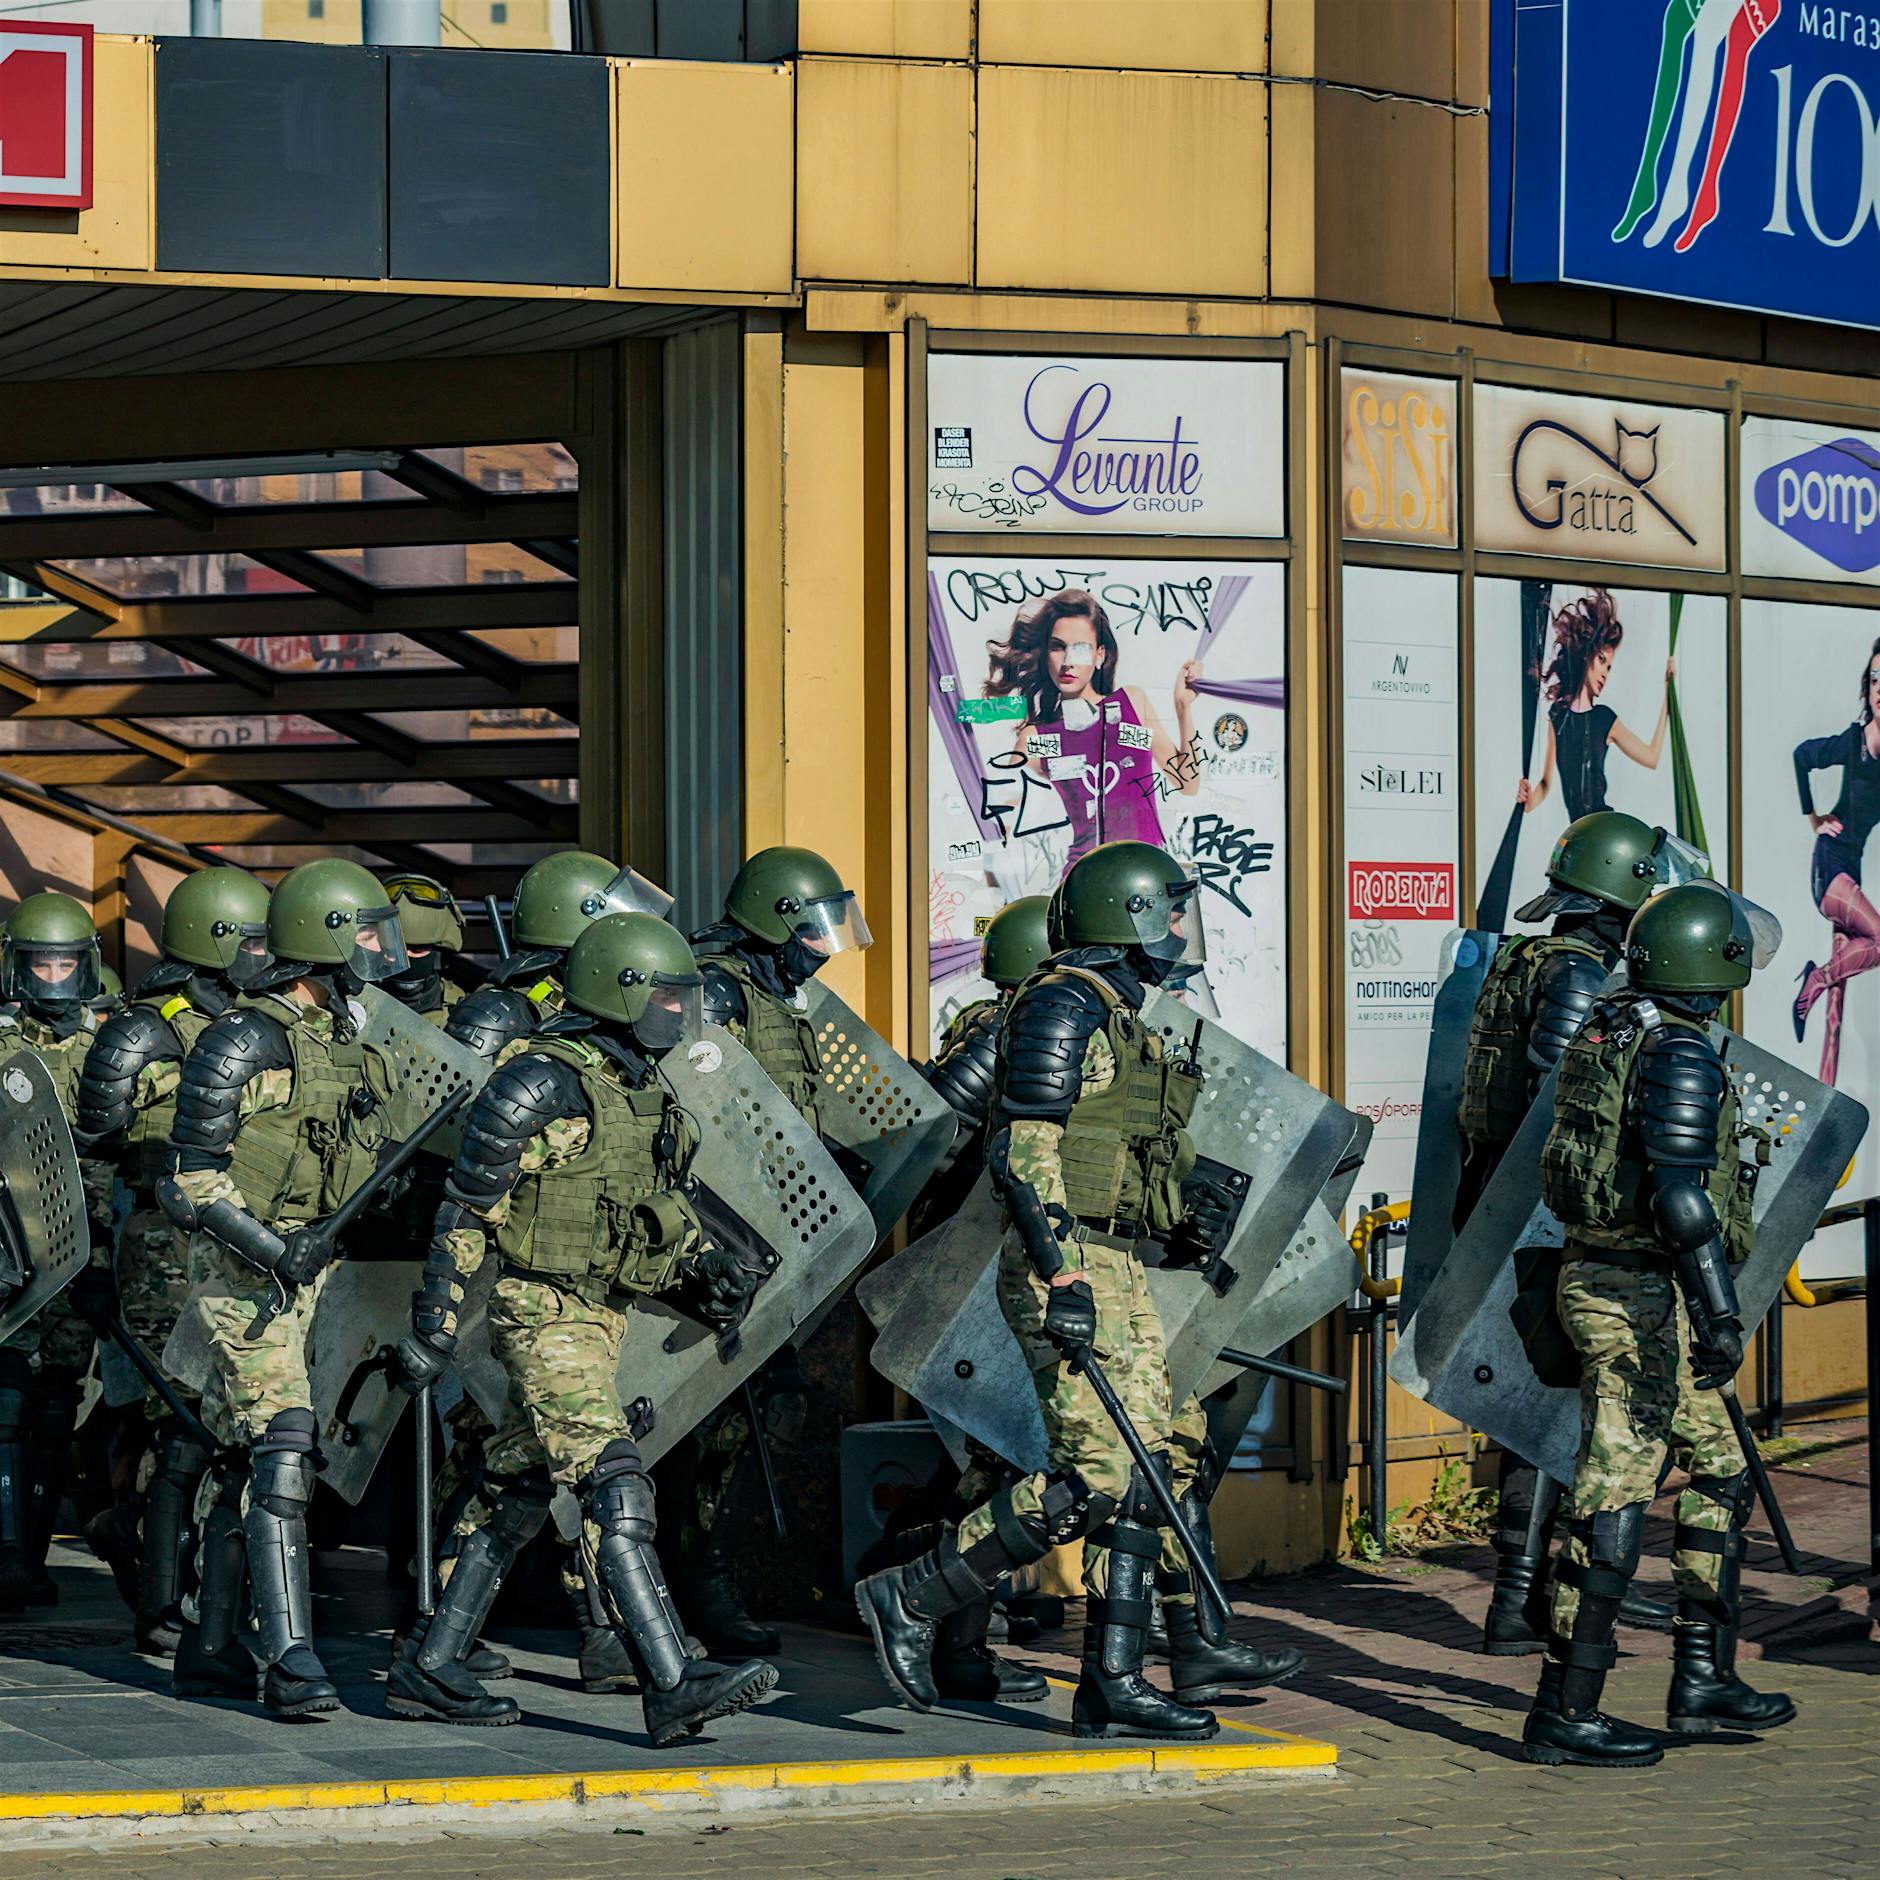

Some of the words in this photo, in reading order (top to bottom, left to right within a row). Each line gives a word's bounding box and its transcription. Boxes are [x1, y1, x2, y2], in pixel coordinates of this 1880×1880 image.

[1763, 64, 1880, 248] 10
[1012, 366, 1203, 516] Levante
[1133, 497, 1203, 513] GROUP
[1512, 419, 1640, 535] Gatta
[1778, 468, 1880, 534] pomp
[1353, 870, 1450, 915] ROBERTA
[1358, 1012, 1385, 1021] AMICO
[1387, 1012, 1403, 1021] PER
[1407, 1012, 1417, 1021] LA
